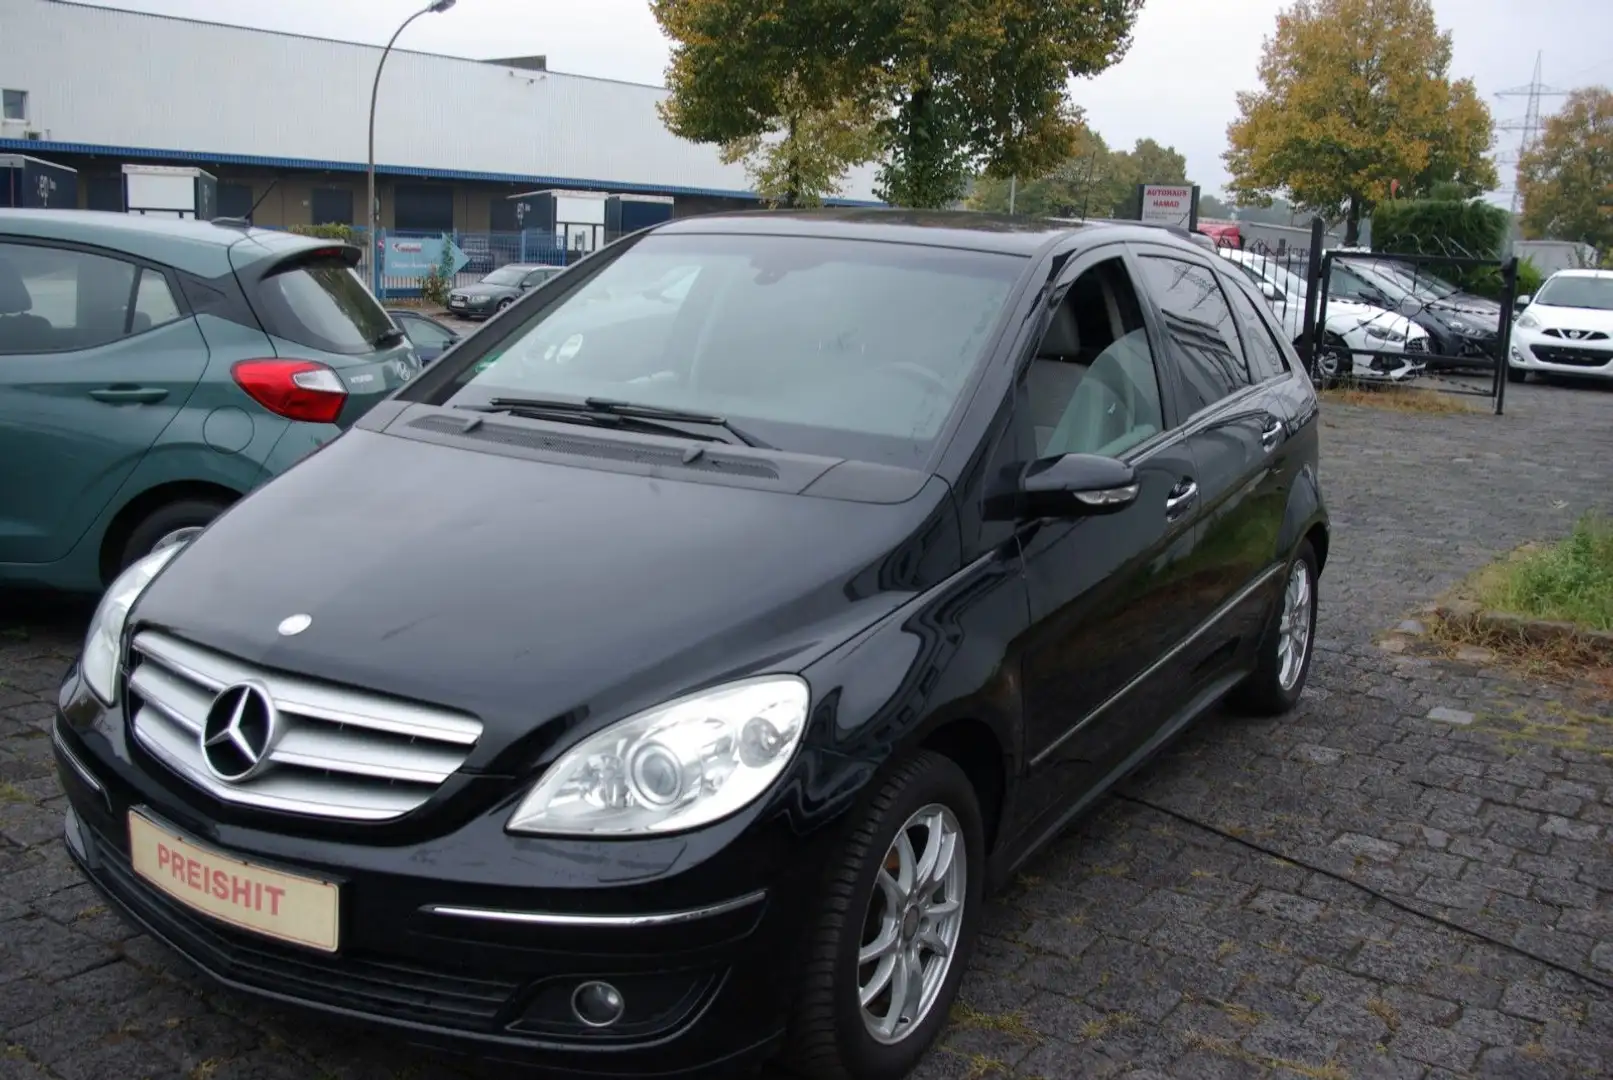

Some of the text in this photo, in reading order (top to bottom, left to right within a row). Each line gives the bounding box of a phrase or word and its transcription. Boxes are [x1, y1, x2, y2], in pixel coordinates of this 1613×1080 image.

[1146, 188, 1188, 198] AUTOHAUS
[1153, 199, 1180, 208] HAMAD
[157, 842, 286, 916] PREISHIT
